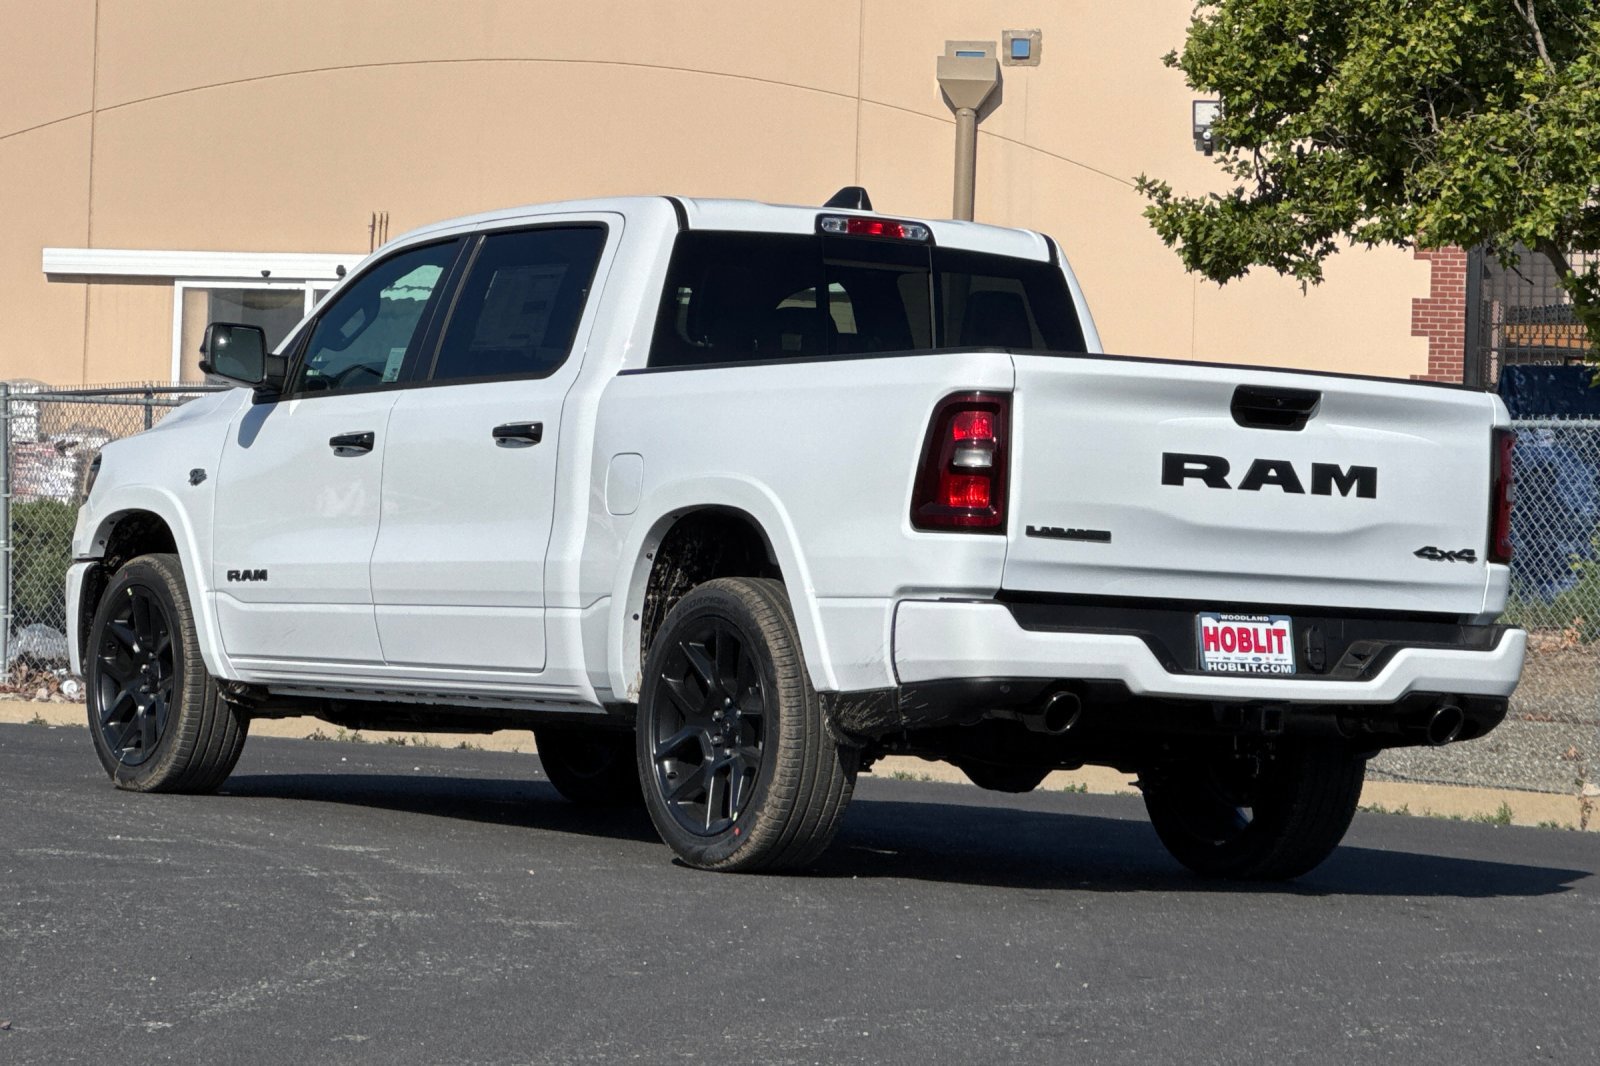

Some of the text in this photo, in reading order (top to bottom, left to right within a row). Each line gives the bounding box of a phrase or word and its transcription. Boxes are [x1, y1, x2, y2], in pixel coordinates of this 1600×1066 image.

[1161, 451, 1378, 499] RAM
[1412, 545, 1478, 564] 4x4
[227, 569, 268, 582] RAM
[1220, 614, 1269, 622] WOODLAND
[1203, 626, 1287, 654] HOBLIT
[1207, 662, 1292, 674] HOBLIT.COM
